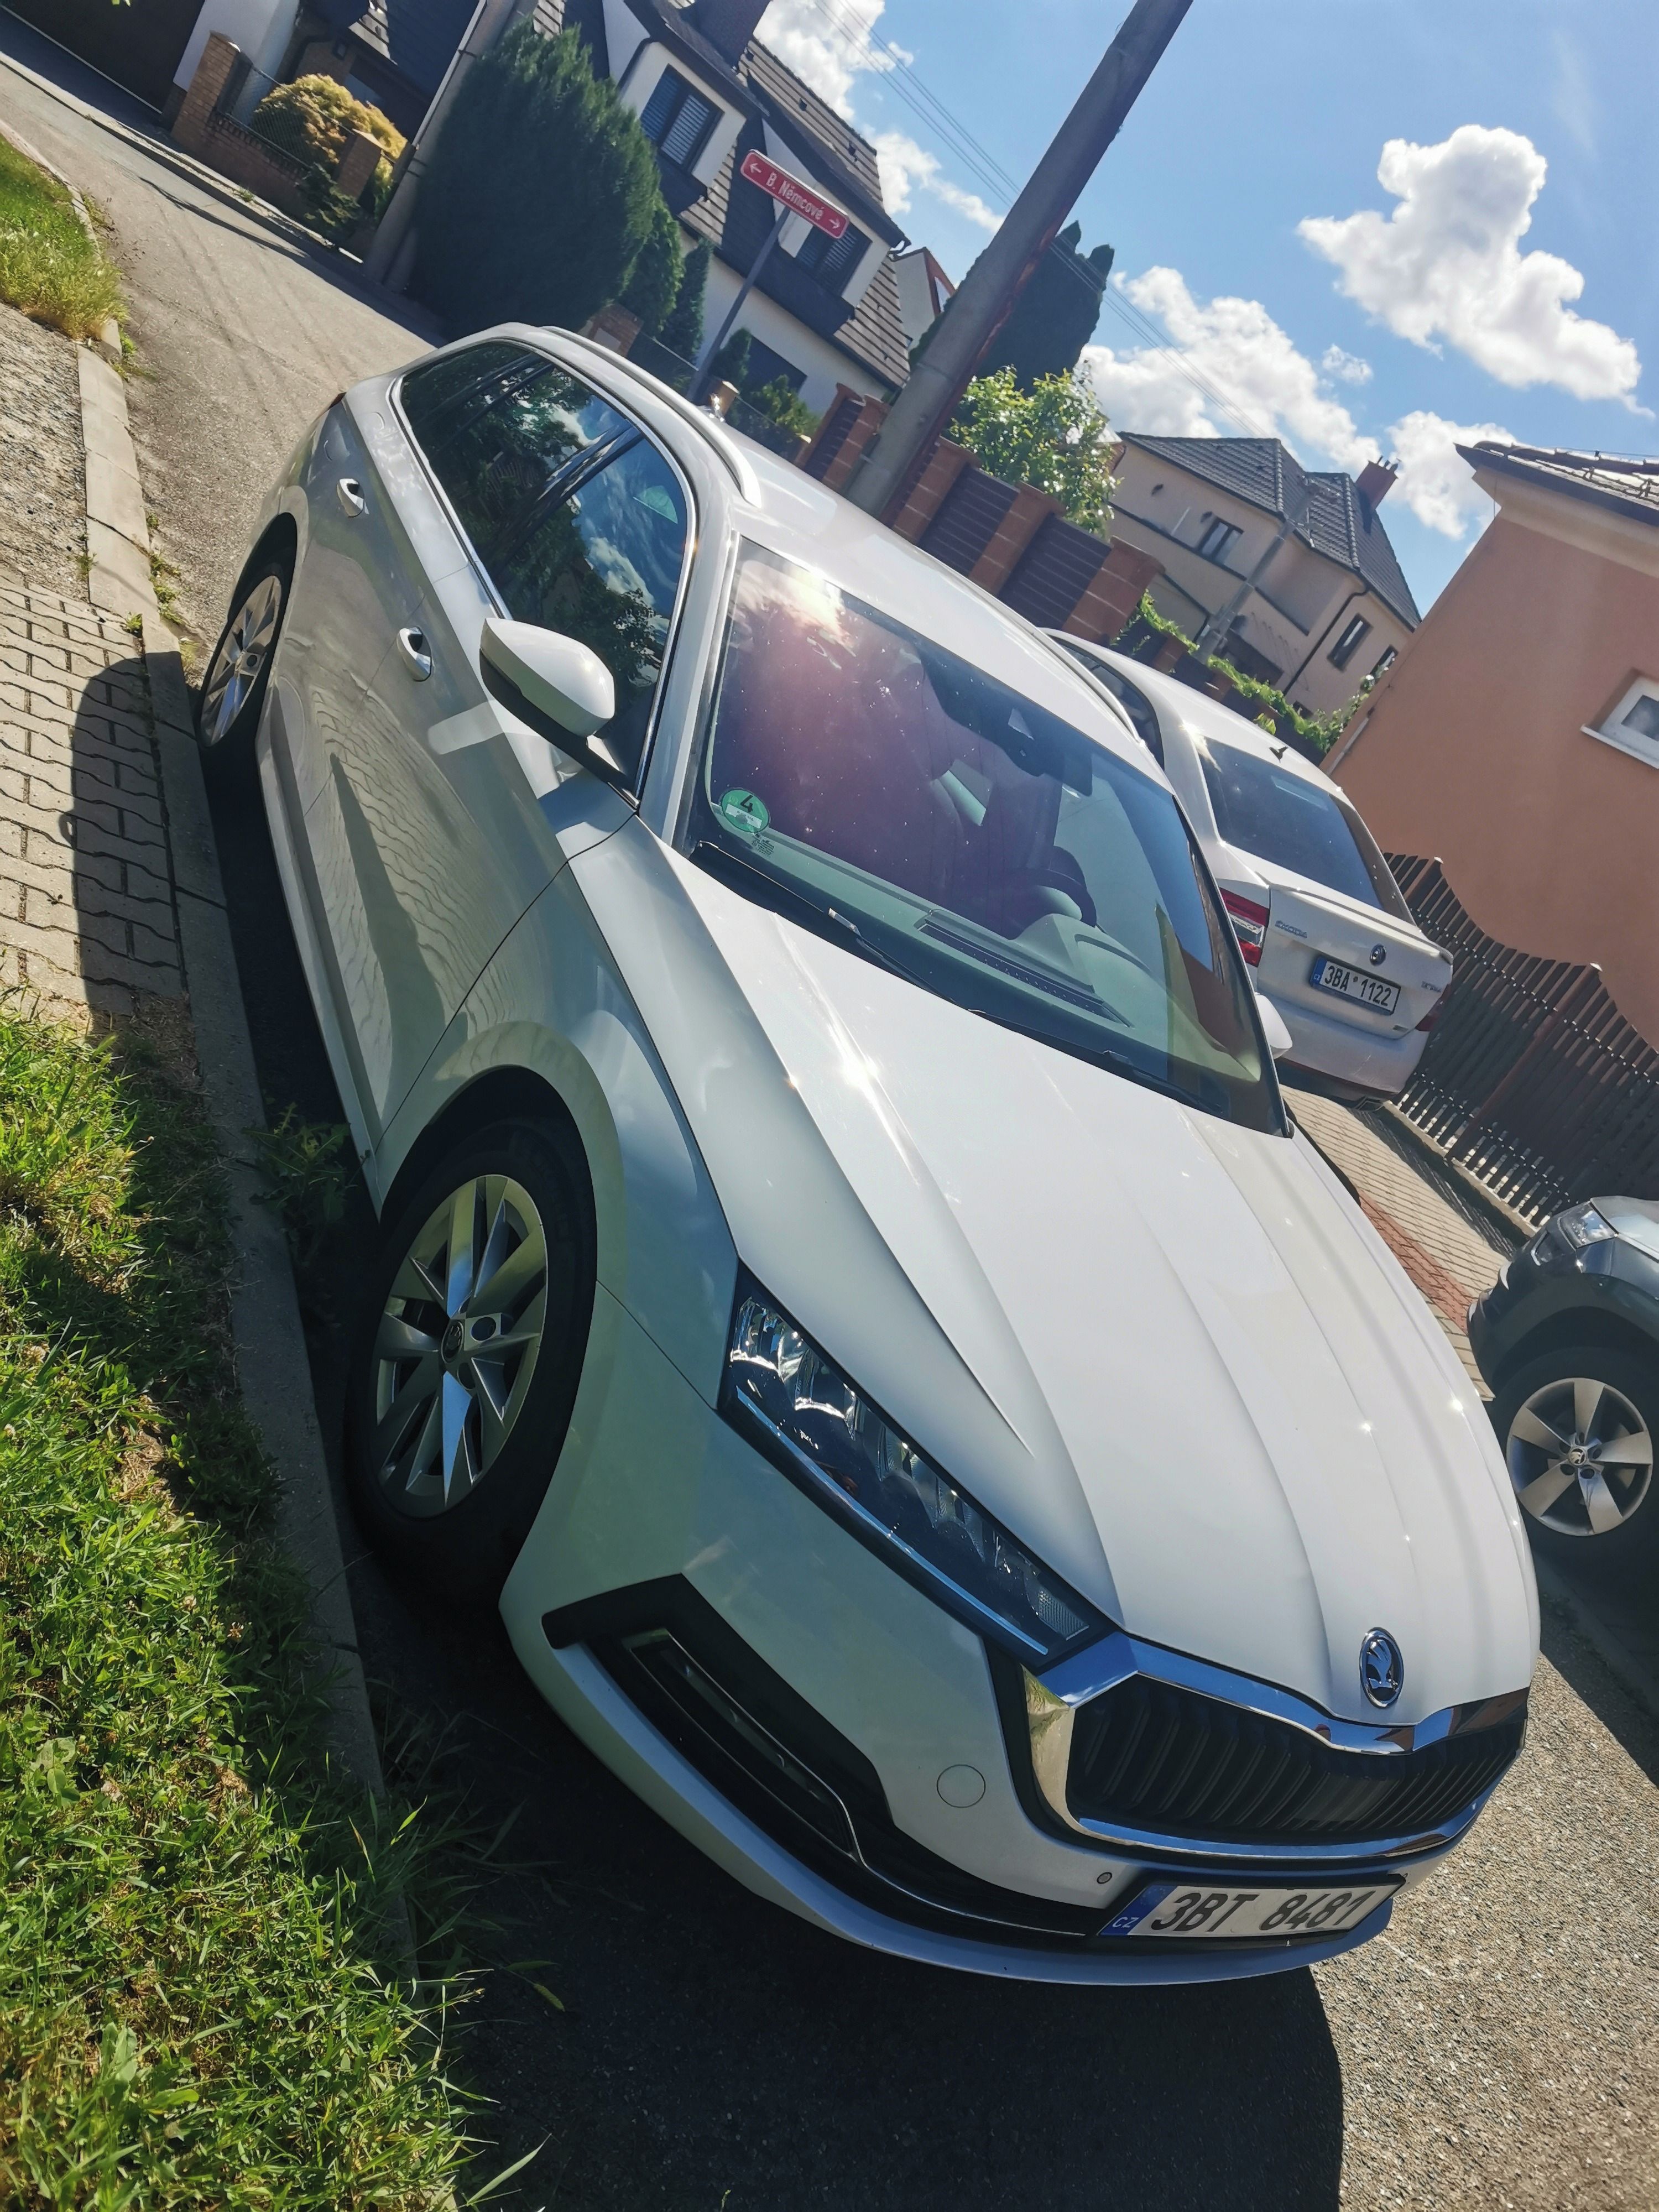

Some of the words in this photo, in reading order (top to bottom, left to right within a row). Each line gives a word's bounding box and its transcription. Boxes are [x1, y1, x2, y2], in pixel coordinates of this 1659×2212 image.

[765, 172, 778, 190] B.
[778, 180, 825, 220] Němcové
[740, 794, 753, 813] 4
[1324, 965, 1350, 992] 3BA
[1361, 978, 1391, 1006] 1122
[1112, 1916, 1140, 1928] CZ
[1151, 1892, 1260, 1932] 3BT
[1258, 1890, 1376, 1931] 8481
